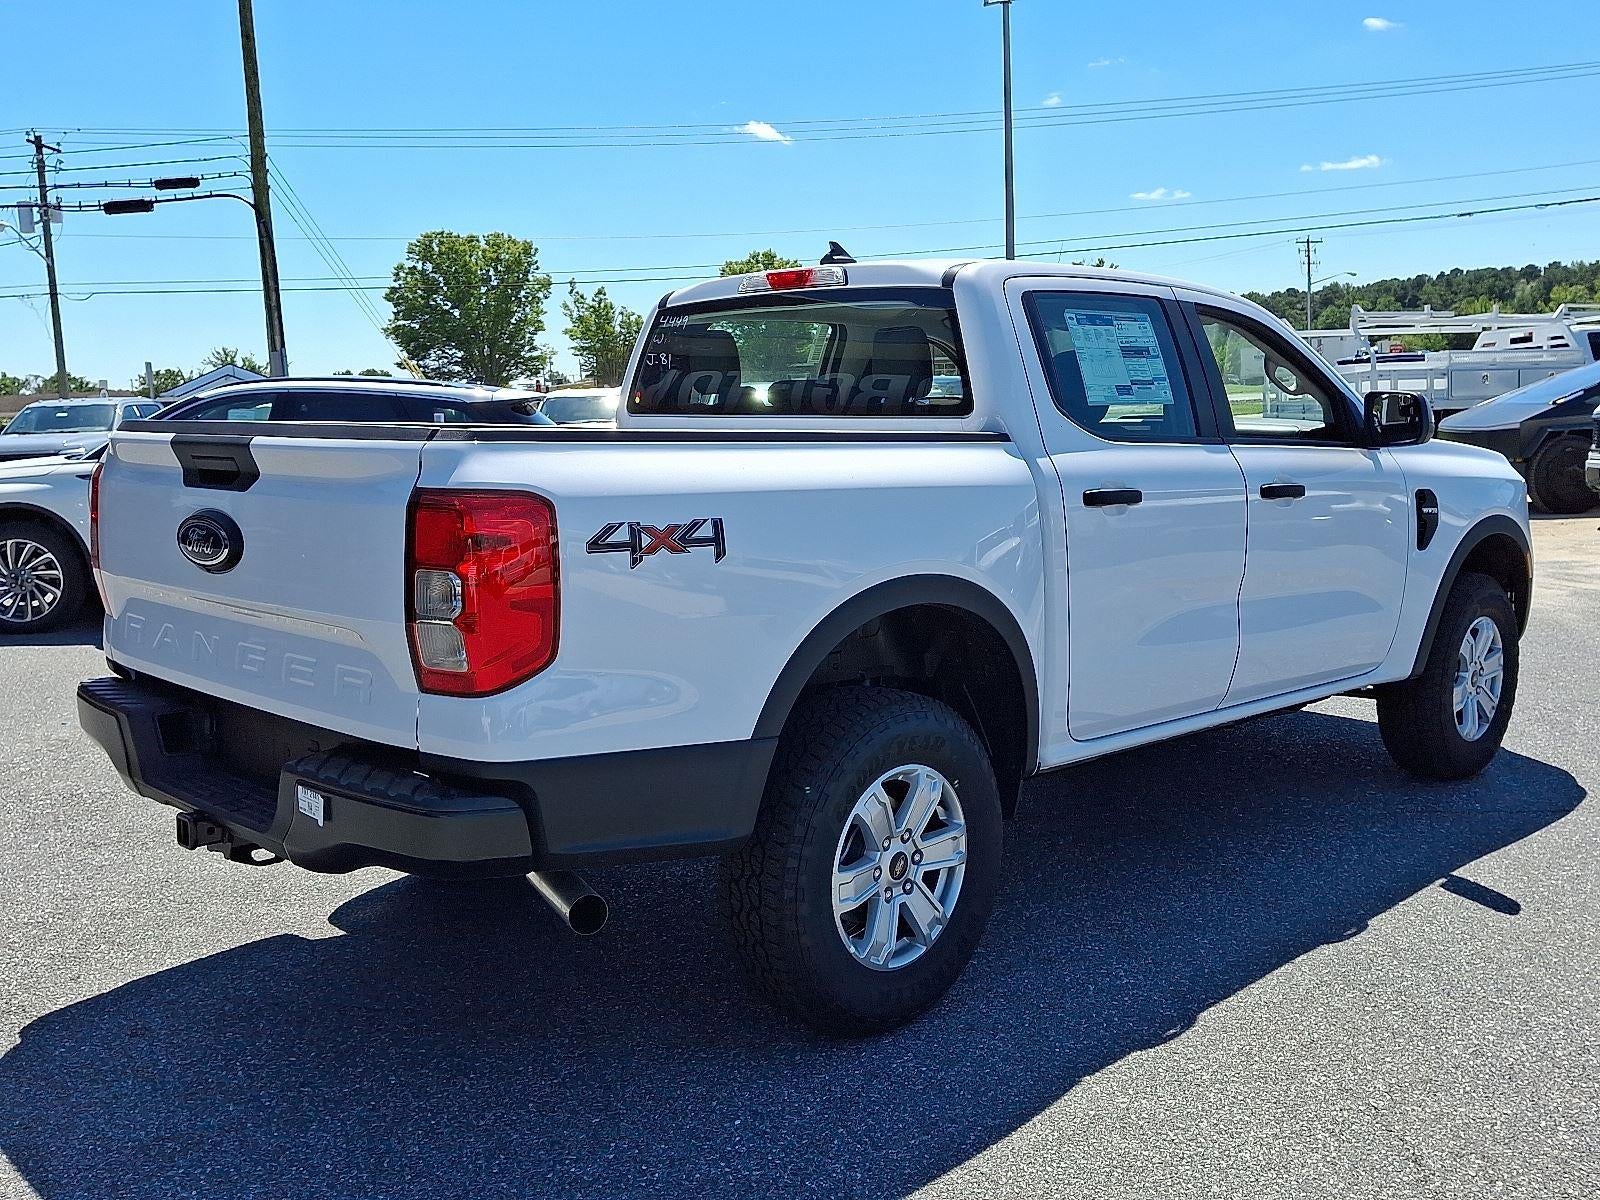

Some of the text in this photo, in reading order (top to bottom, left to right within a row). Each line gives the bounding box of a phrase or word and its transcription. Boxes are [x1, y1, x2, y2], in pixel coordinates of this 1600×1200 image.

[660, 315, 689, 330] 4449
[186, 527, 214, 554] Ford
[123, 611, 375, 706] RANGER
